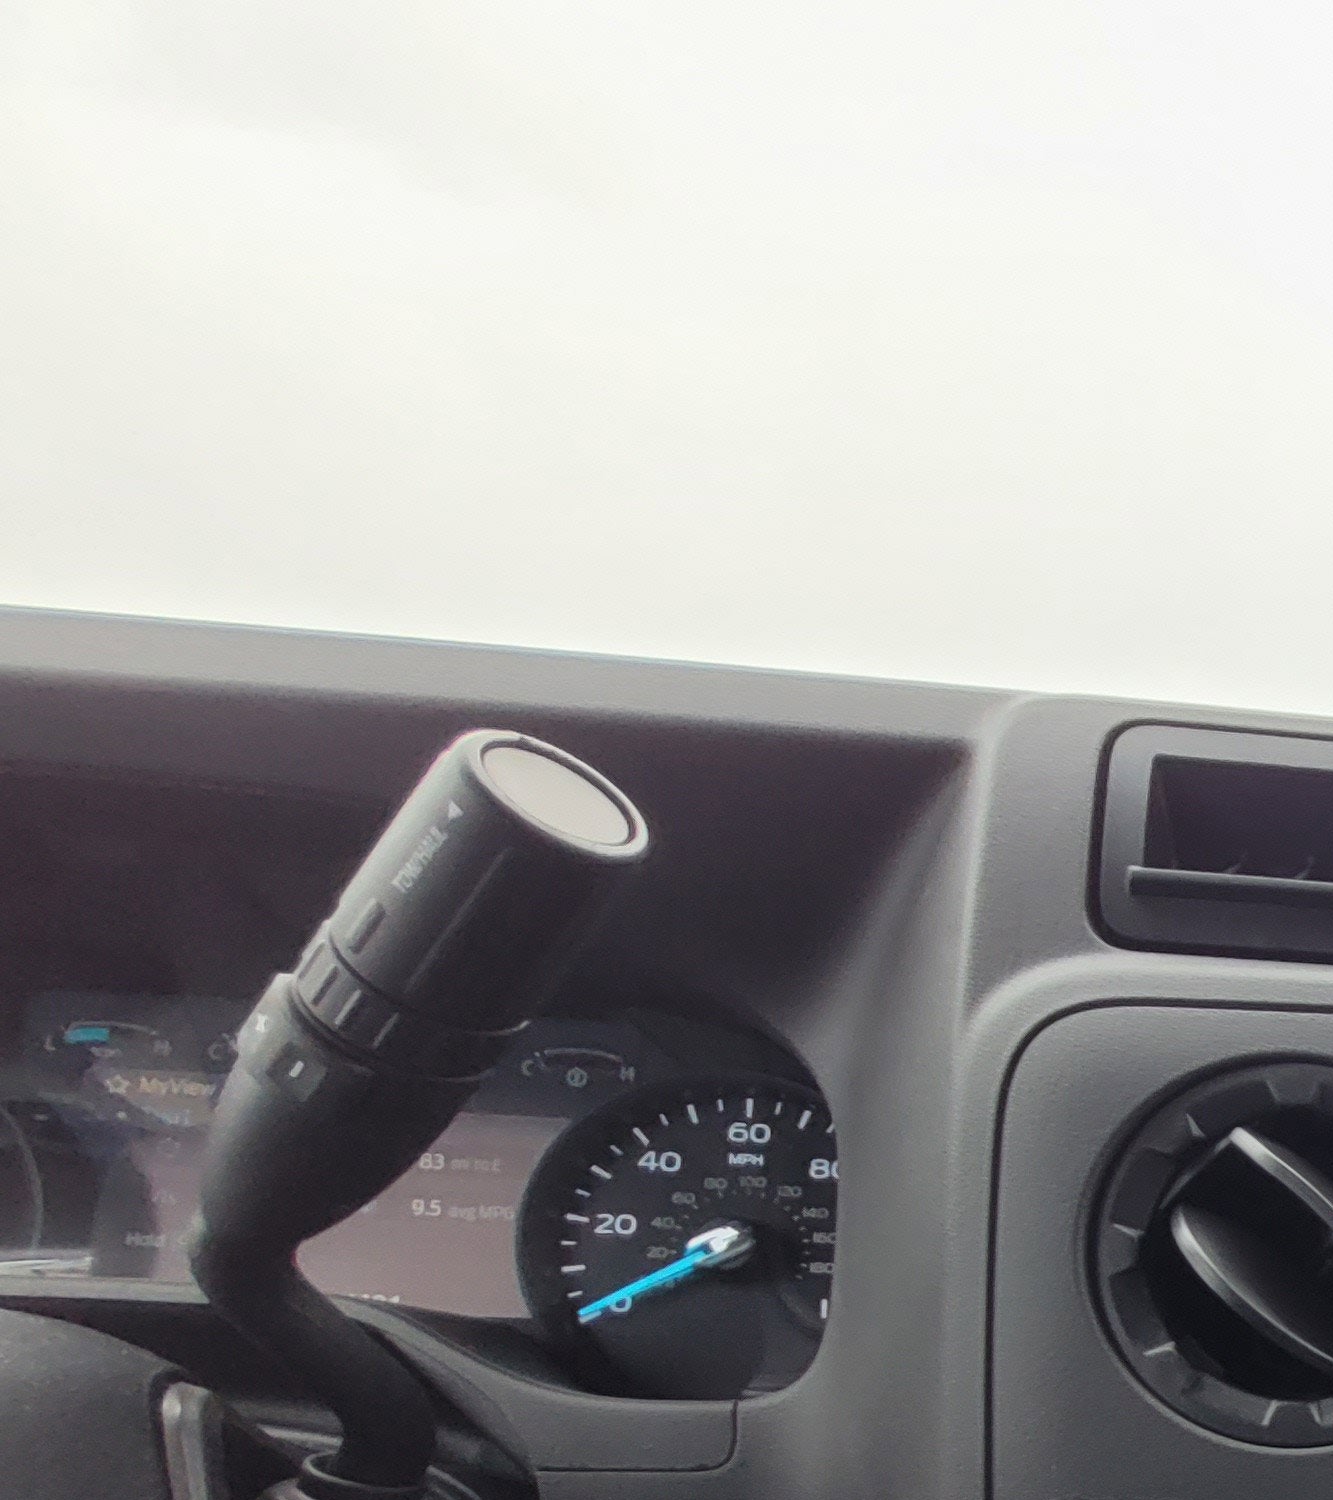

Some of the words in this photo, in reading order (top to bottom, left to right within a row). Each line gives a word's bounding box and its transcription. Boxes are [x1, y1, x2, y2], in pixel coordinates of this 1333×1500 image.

[726, 1121, 772, 1144] 60
[418, 1152, 447, 1170] 83
[637, 1150, 682, 1173] 40
[728, 1151, 764, 1167] MPH
[410, 1199, 442, 1217] 9.5
[593, 1212, 638, 1236] 20
